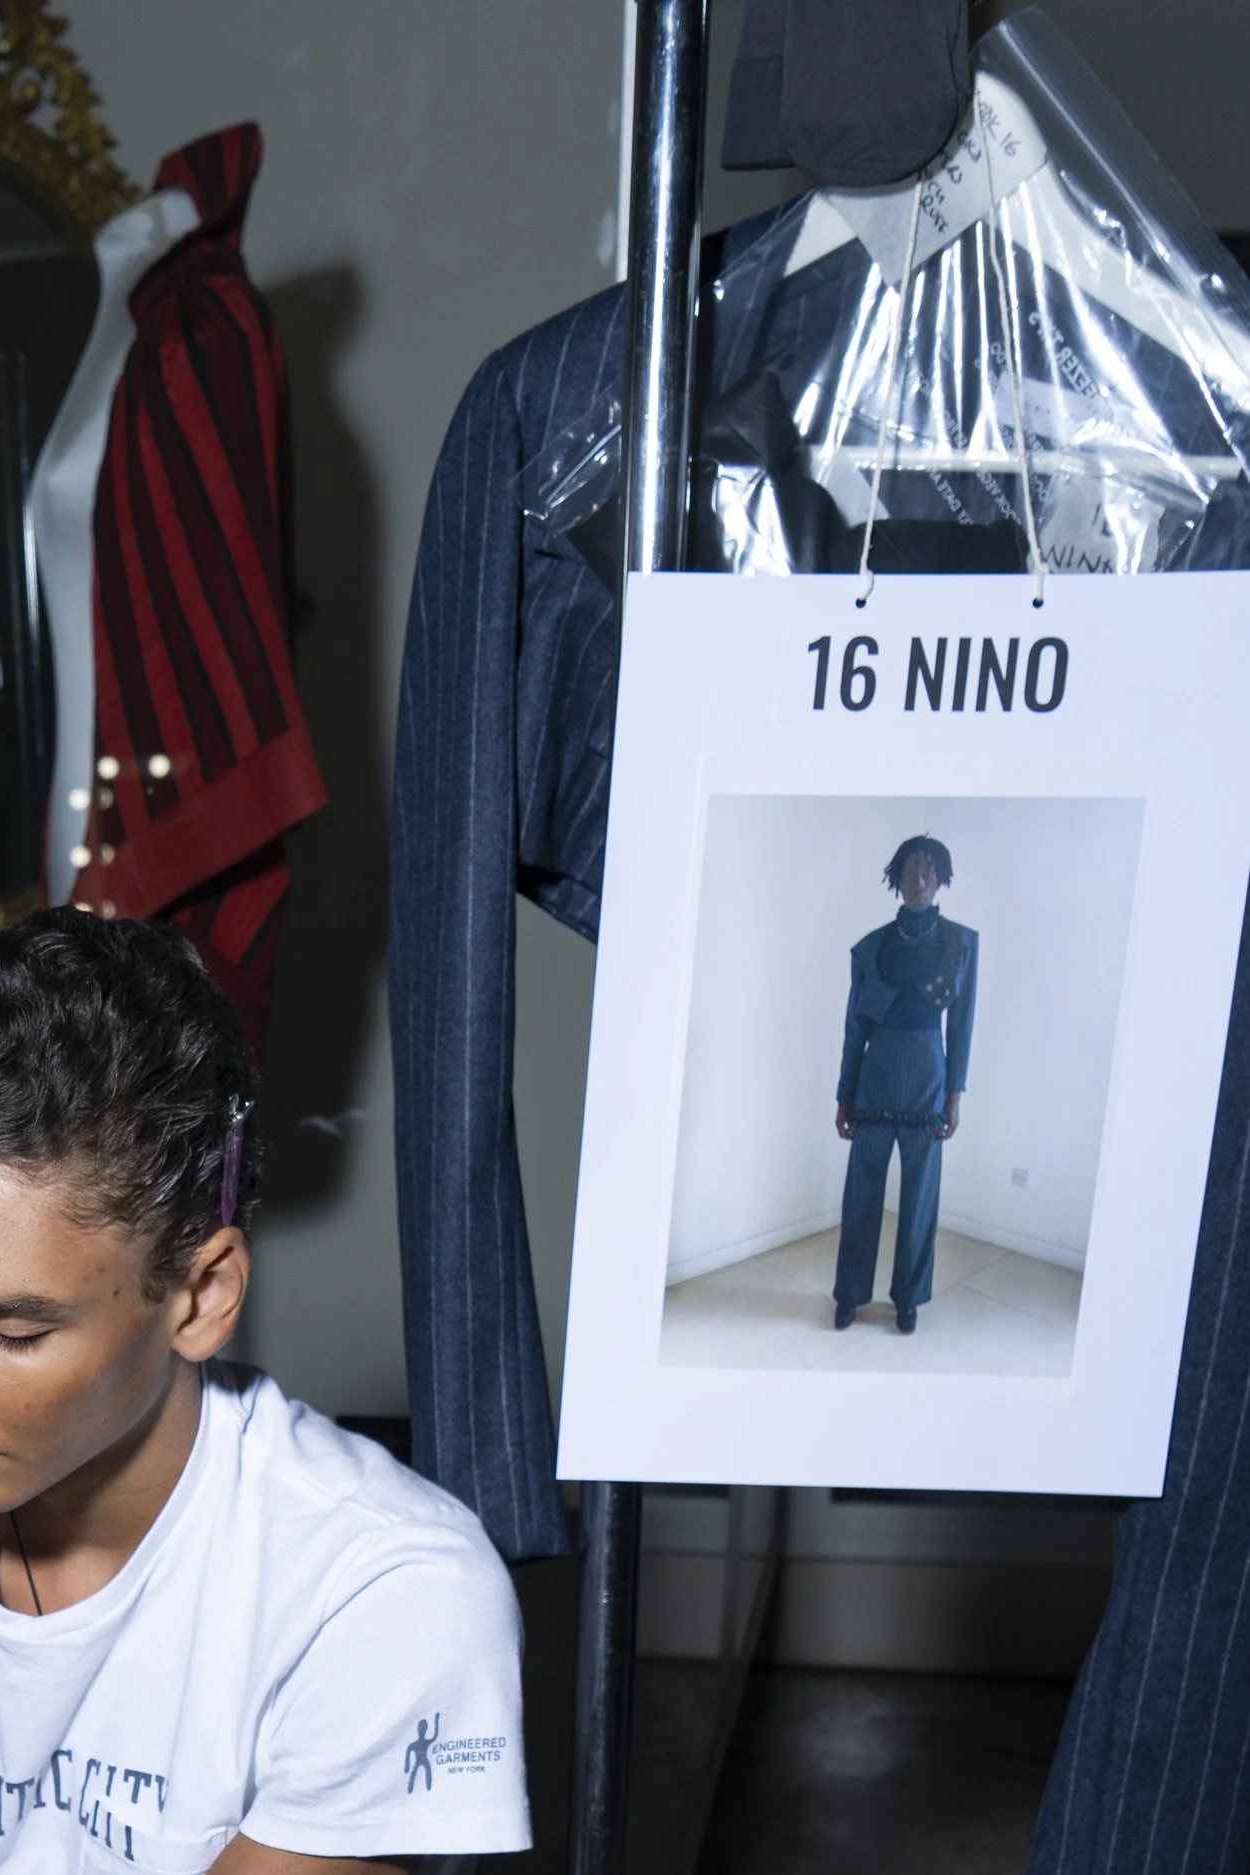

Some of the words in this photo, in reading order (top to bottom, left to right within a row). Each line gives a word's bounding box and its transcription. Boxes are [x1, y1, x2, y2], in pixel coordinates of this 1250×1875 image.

[808, 636, 879, 712] 16
[904, 637, 1069, 714] NINO
[432, 1737, 507, 1754] ENGINEERED
[436, 1751, 501, 1765] GARMENTS
[466, 1765, 486, 1773] YORK
